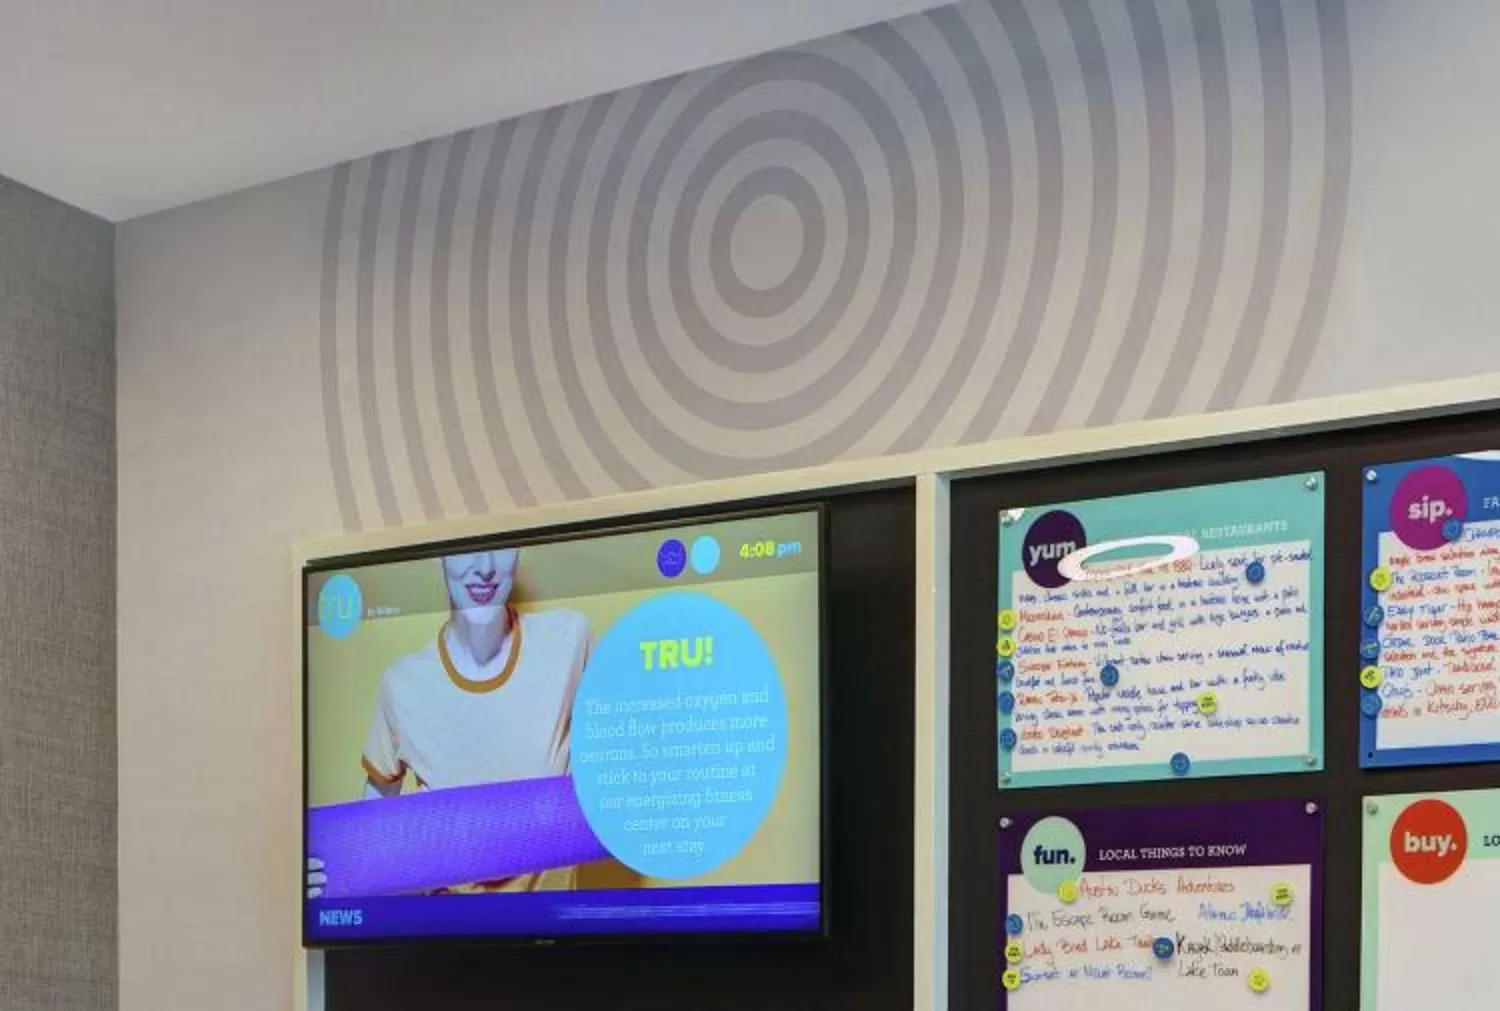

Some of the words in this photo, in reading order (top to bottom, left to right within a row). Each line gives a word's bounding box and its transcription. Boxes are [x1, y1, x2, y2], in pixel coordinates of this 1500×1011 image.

[1408, 494, 1453, 524] sip.
[739, 540, 776, 558] 4:08
[776, 541, 801, 558] pm
[639, 635, 714, 671] TRU!
[1098, 848, 1138, 861] LOCAL
[1140, 846, 1185, 860] THINGS
[1188, 846, 1205, 858] TO
[1207, 844, 1248, 858] KNOW
[1403, 831, 1457, 857] buy.
[1033, 845, 1077, 865] fun.
[319, 909, 364, 927] NEWS
